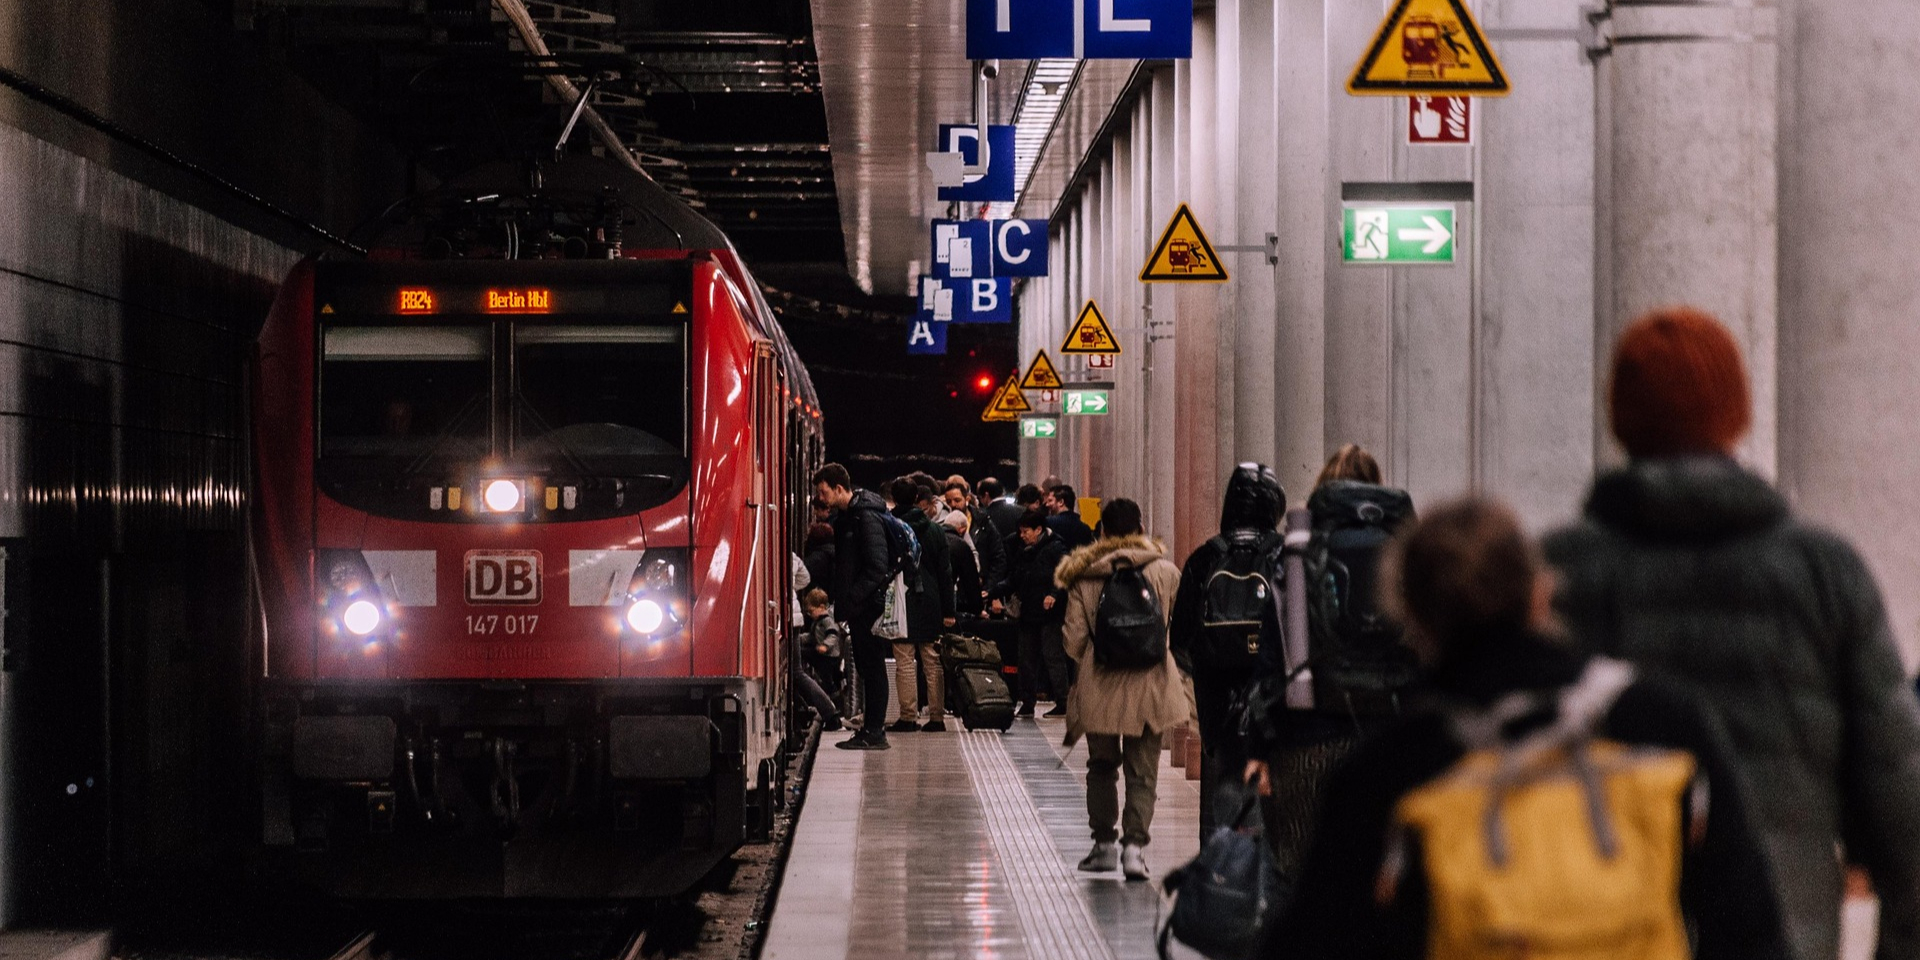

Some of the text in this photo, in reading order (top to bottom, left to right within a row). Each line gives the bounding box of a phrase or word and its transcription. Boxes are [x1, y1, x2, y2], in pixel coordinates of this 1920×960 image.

[950, 128, 990, 183] D
[998, 219, 1031, 265] C
[401, 291, 431, 309] RB24
[489, 291, 525, 308] Berlin
[972, 279, 998, 312] B
[909, 321, 935, 346] A
[475, 560, 533, 596] DB
[465, 615, 539, 634] 147 017
